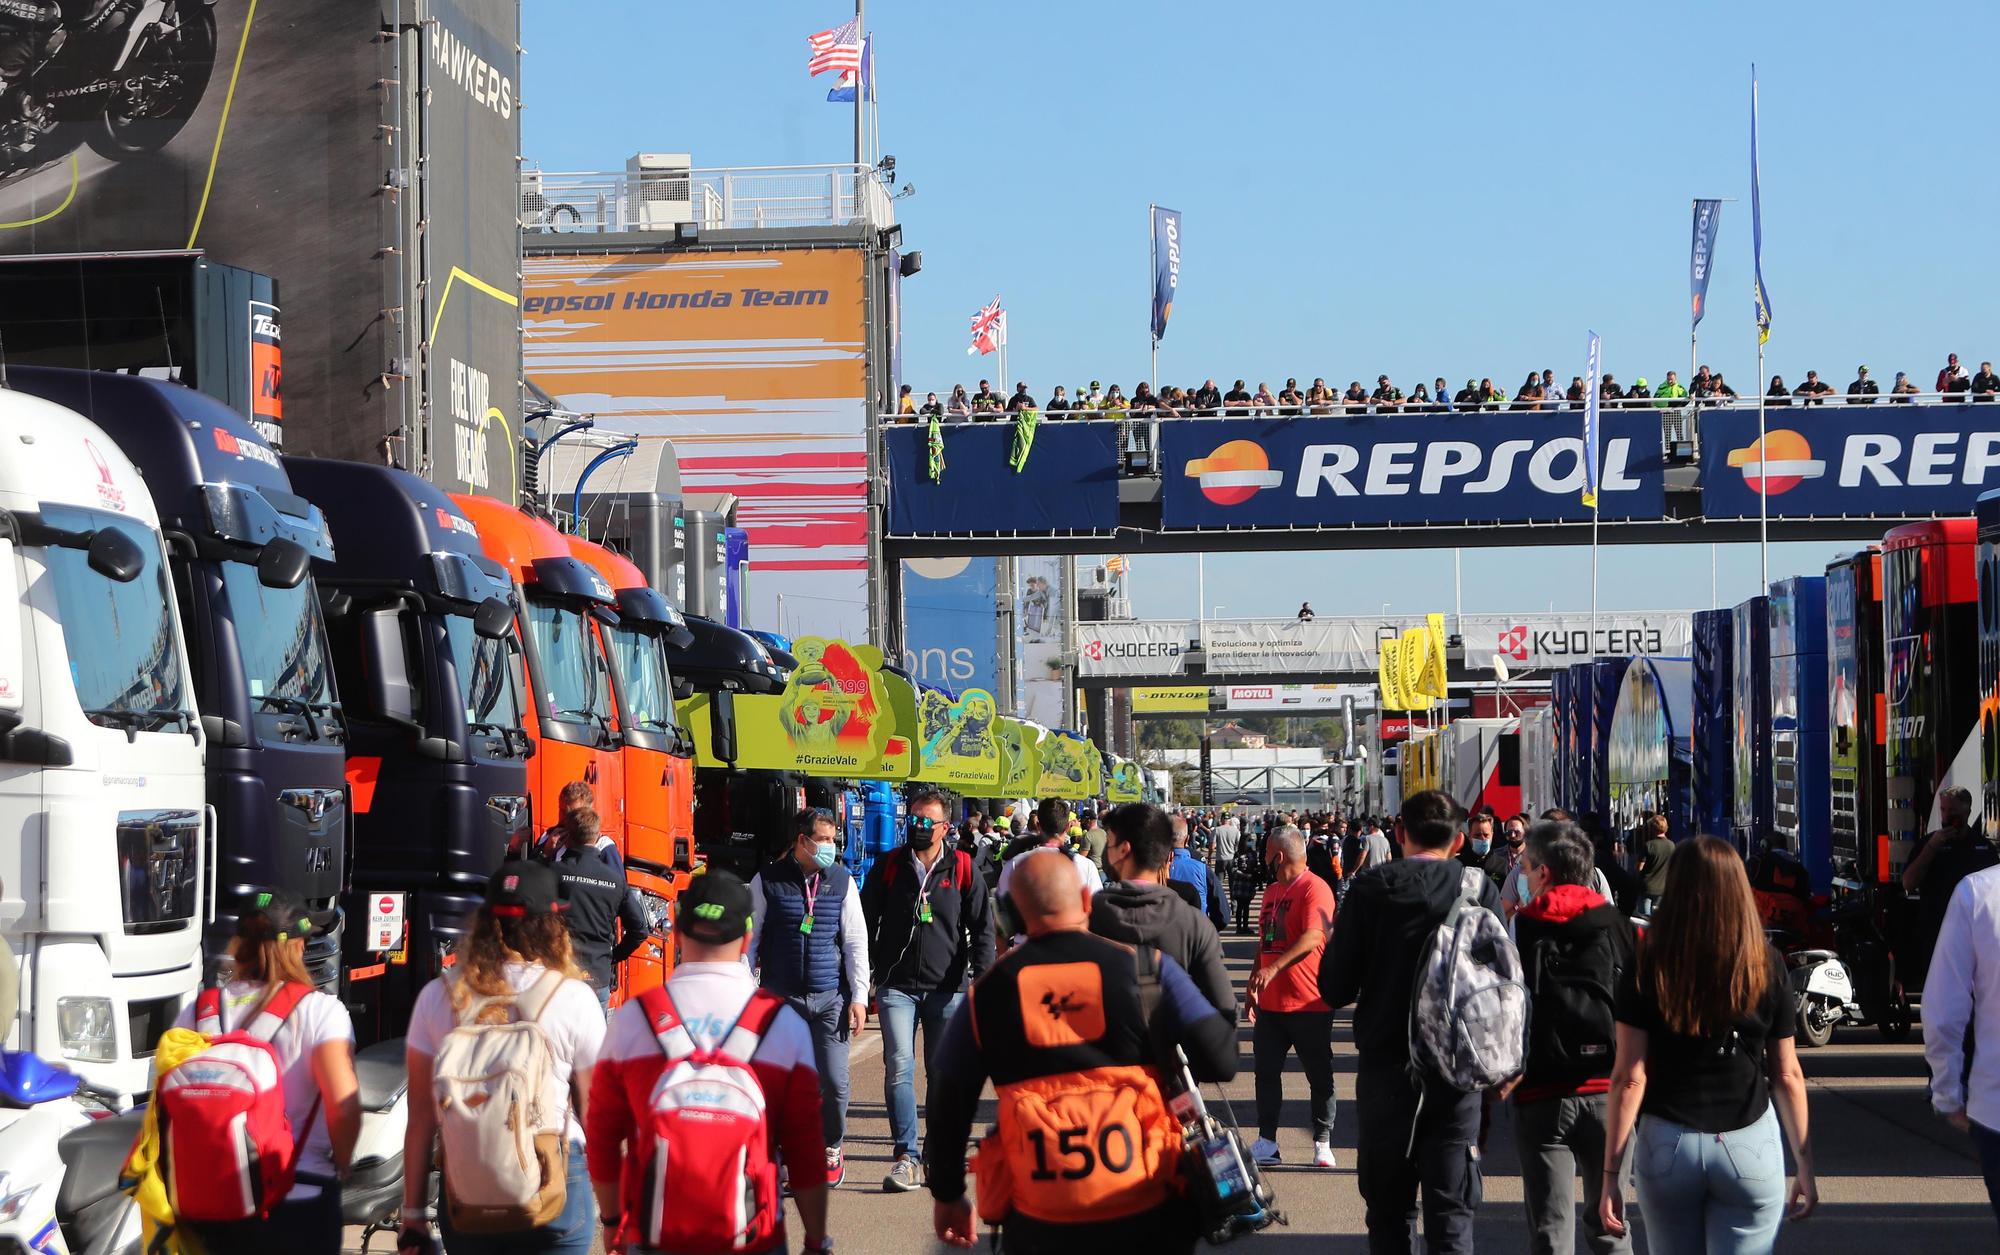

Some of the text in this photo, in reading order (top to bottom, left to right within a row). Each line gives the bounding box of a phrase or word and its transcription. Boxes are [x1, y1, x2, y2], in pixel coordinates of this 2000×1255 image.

[433, 16, 511, 119] HAWKERS
[622, 290, 732, 310] Honda
[741, 289, 829, 307] Team
[451, 357, 469, 421] FUEL
[1296, 436, 1641, 498] REPSOL
[1211, 640, 1257, 648] Evoluciona
[1266, 640, 1303, 649] optimiza
[823, 680, 868, 695] 1999
[1233, 689, 1271, 698] MOTUL
[796, 754, 857, 766] #GrazieVale
[949, 770, 995, 780] #GrazieVale
[562, 875, 617, 889] THE FLYING BULLS
[695, 903, 726, 920] 46
[1027, 1123, 1134, 1181] 150
